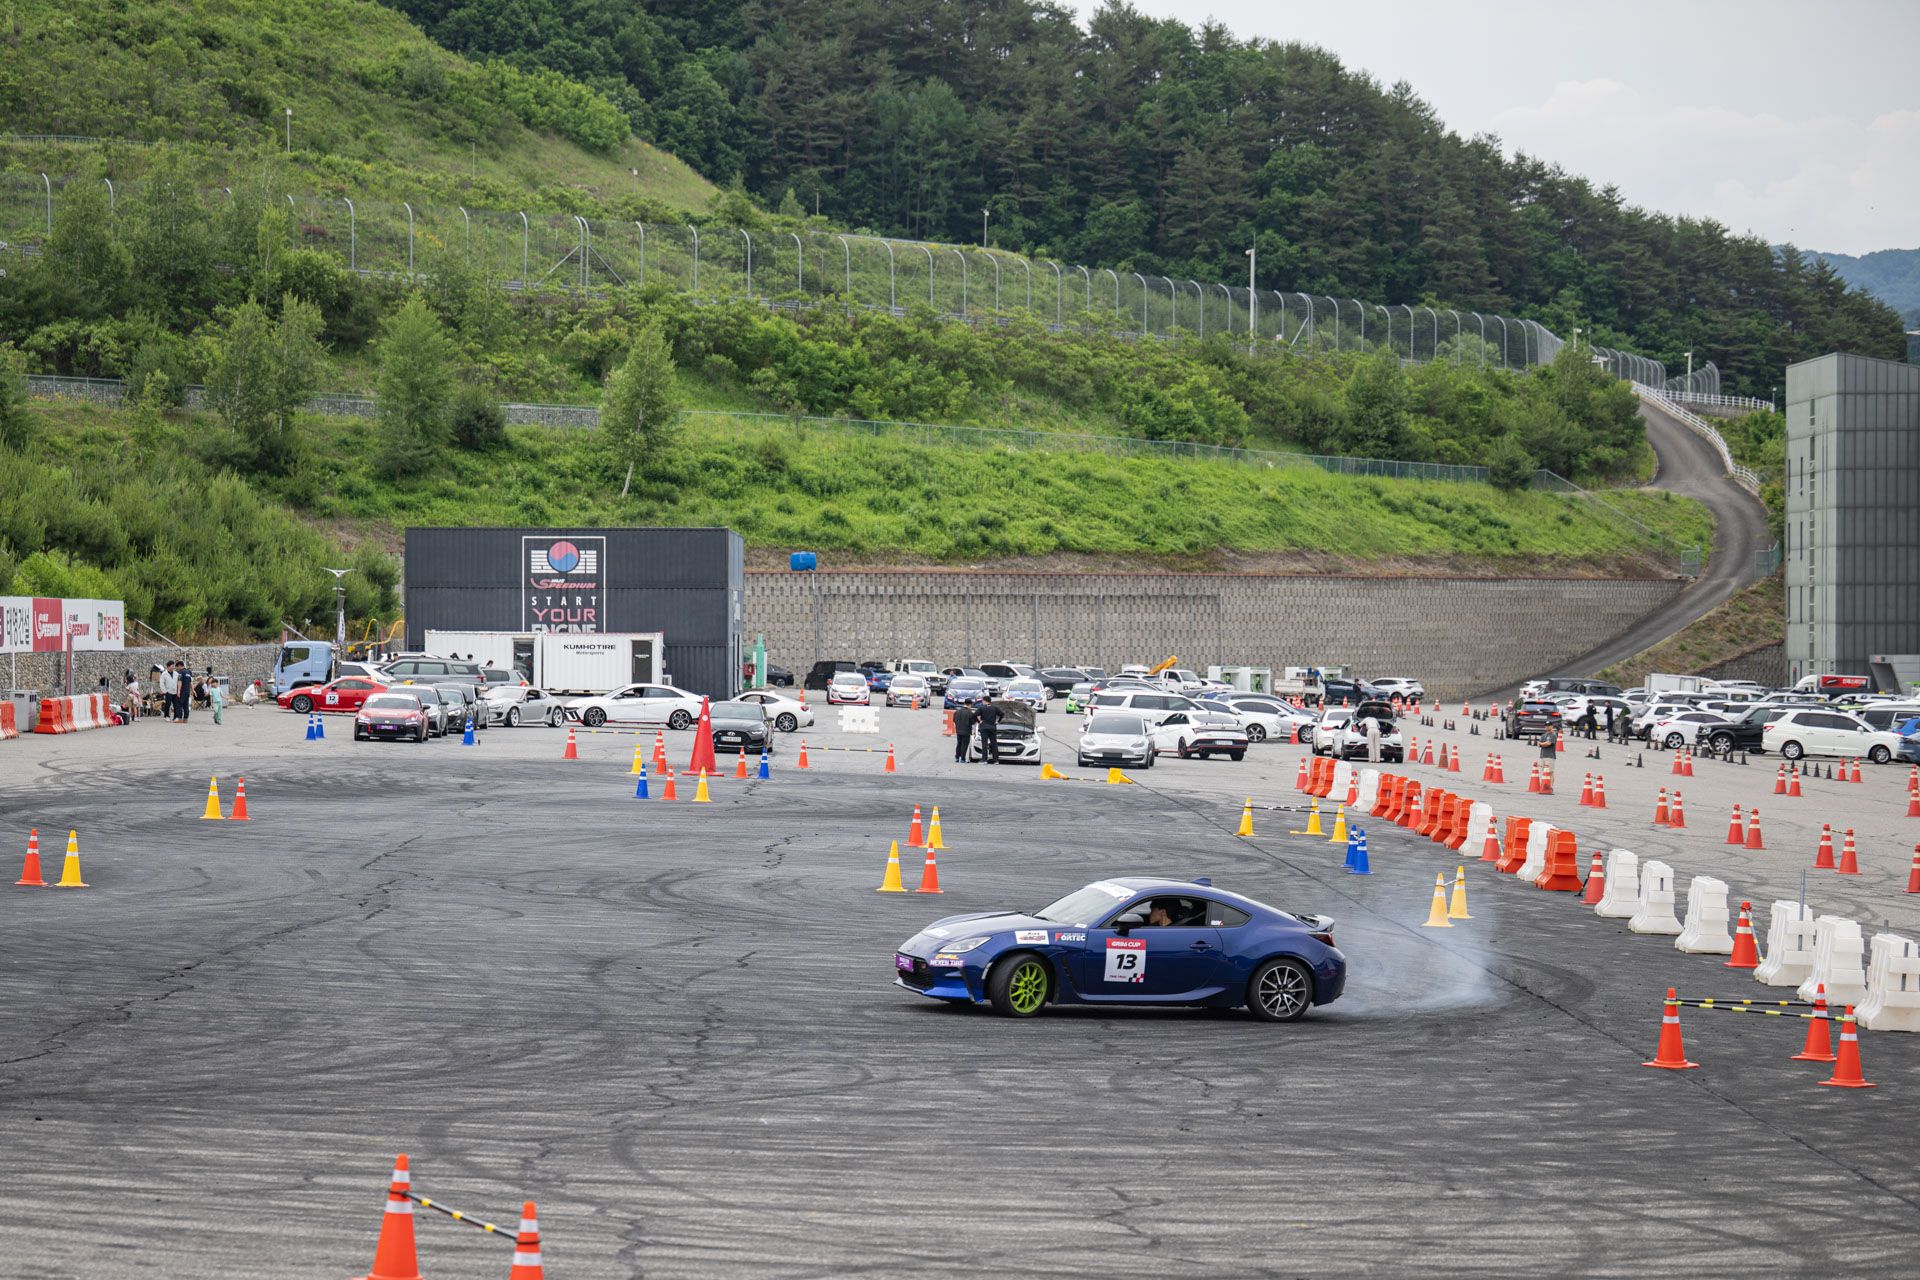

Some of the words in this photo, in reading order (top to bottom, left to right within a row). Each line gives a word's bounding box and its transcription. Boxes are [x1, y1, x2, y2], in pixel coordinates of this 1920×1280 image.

[530, 577, 597, 590] SPEEDIUM
[531, 596, 597, 606] START
[532, 608, 596, 622] YOUR
[6, 607, 30, 647] 태영건설
[929, 959, 949, 967] NEXEN
[1116, 953, 1137, 970] 13
